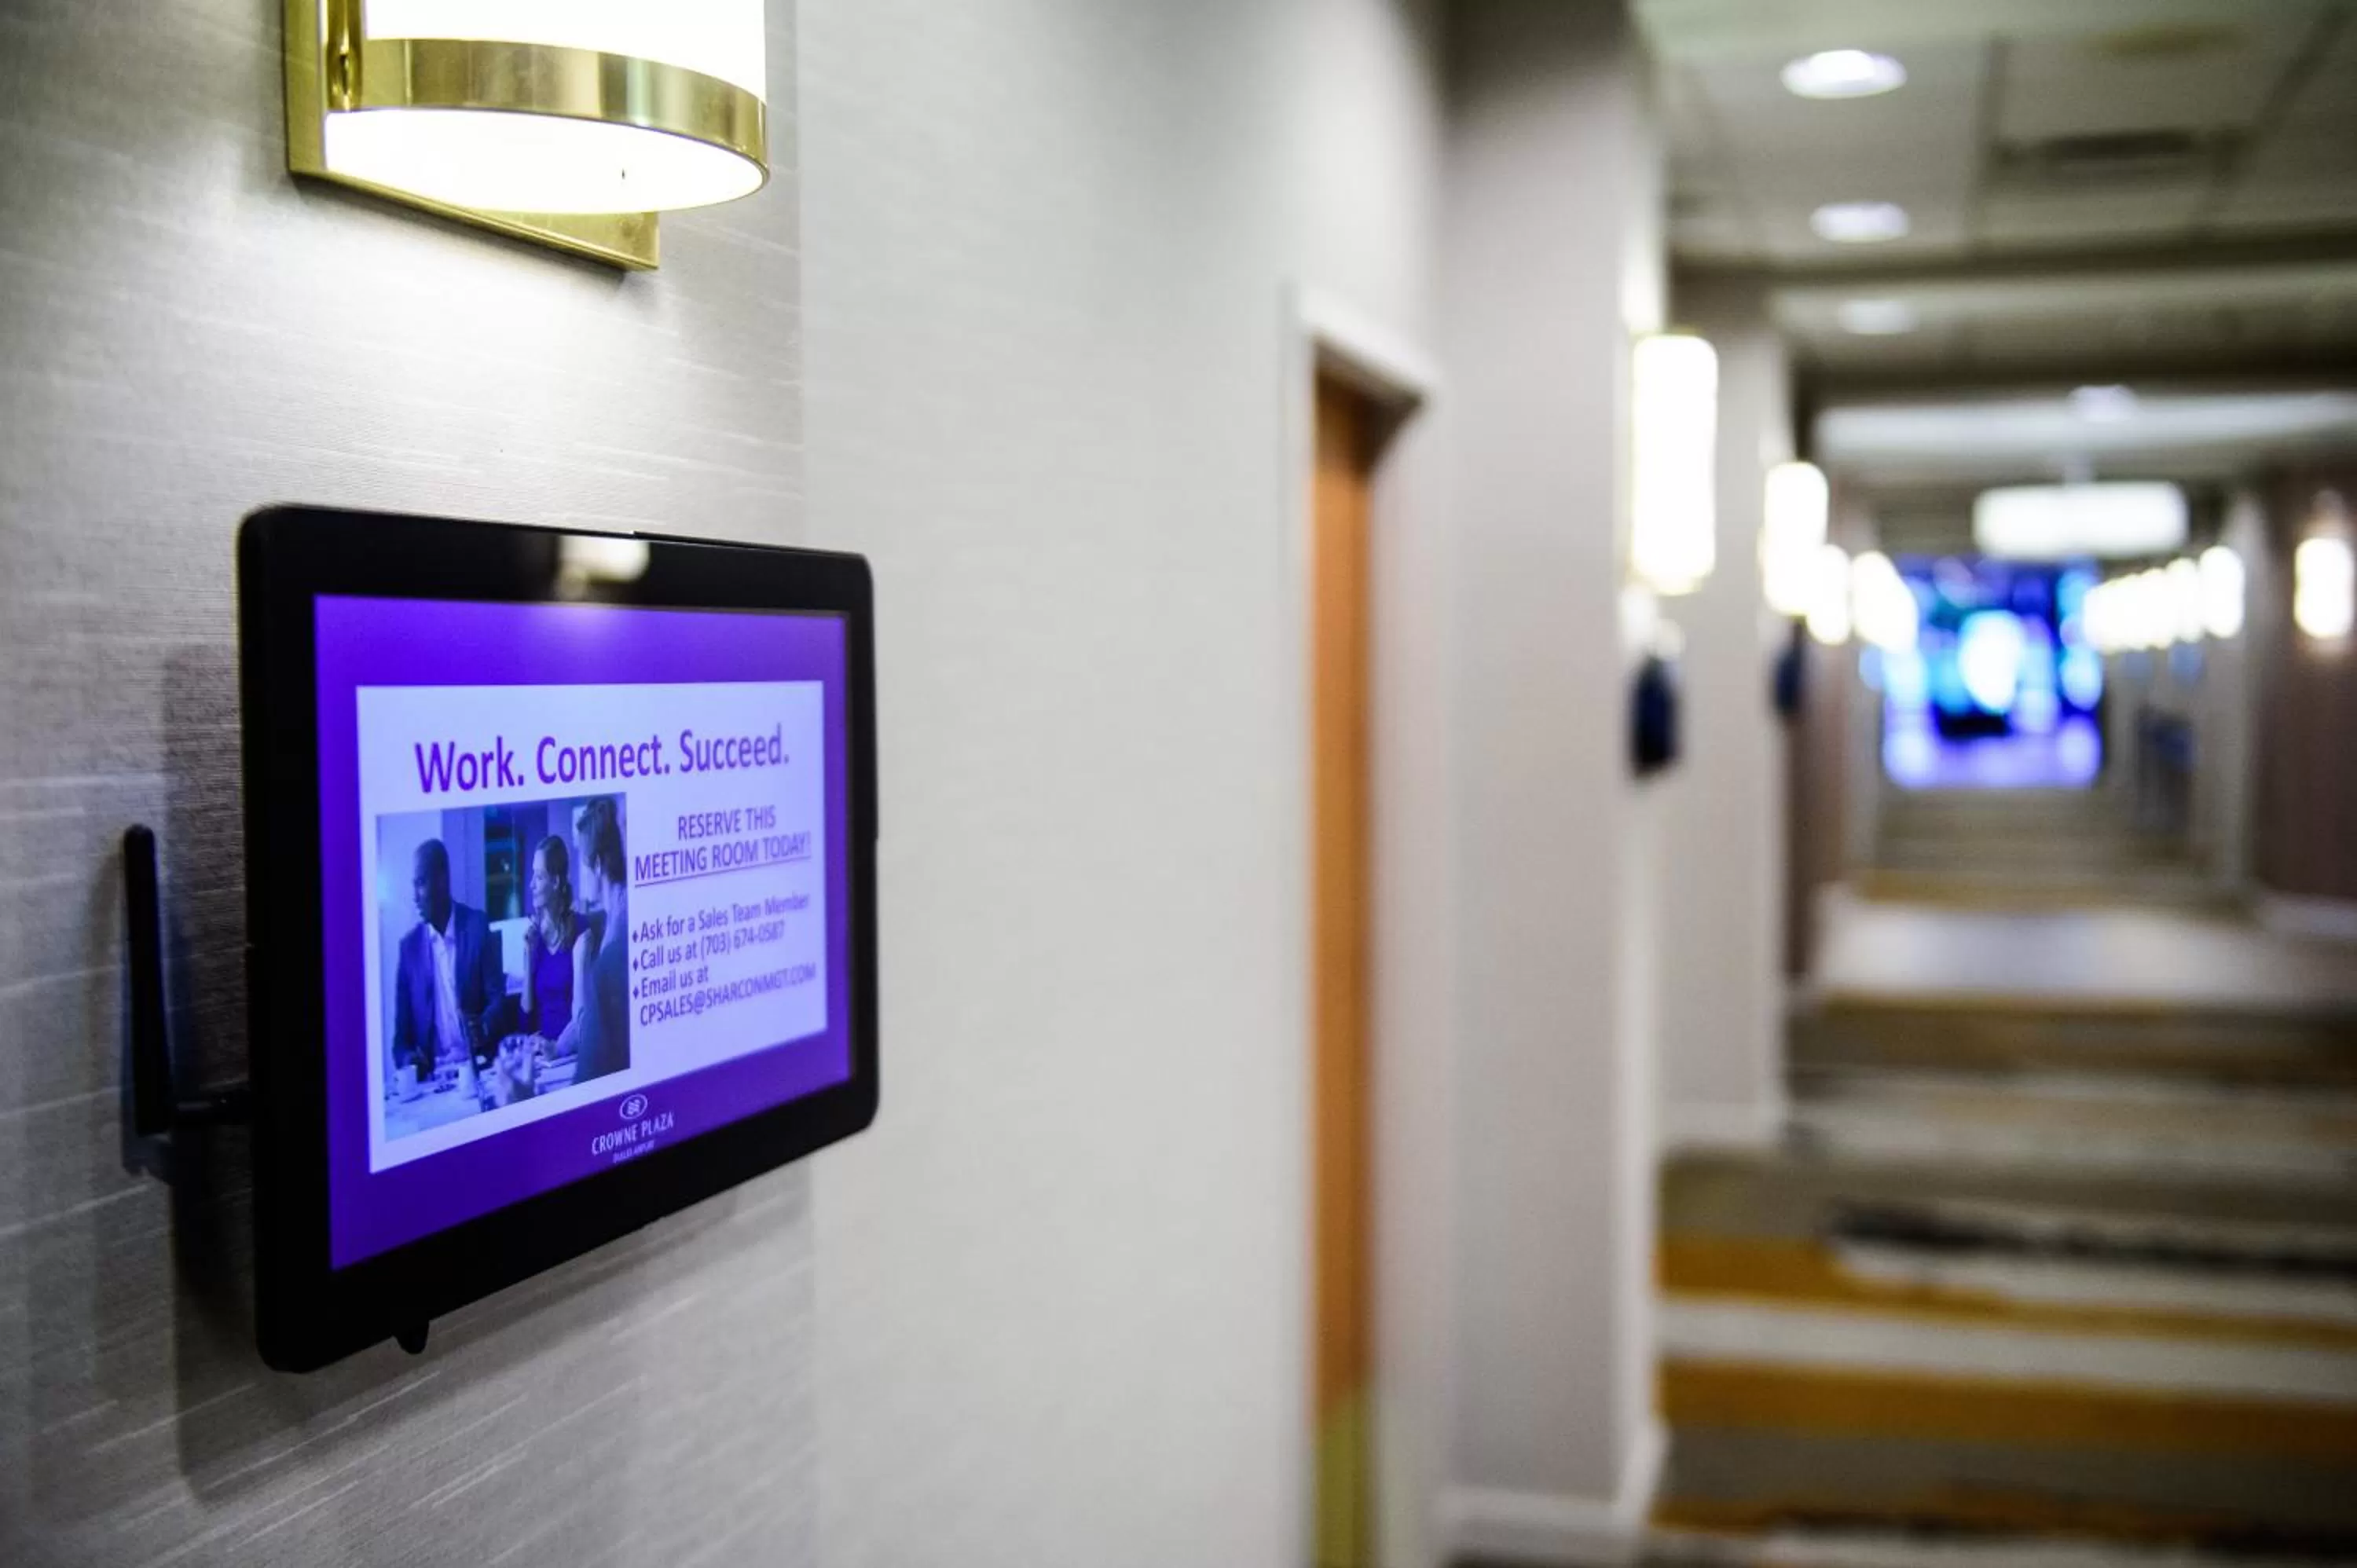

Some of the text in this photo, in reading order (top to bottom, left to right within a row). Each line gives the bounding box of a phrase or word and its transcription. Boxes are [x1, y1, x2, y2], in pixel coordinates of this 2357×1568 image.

[415, 723, 790, 793] Work. Connect. Succeed.
[678, 804, 776, 841] RESERVE THIS
[635, 830, 811, 881] MEETING ROOM TODAY!
[640, 918, 663, 943] Ask
[667, 915, 684, 937] for
[687, 917, 695, 932] a
[699, 906, 728, 930] Sales
[732, 902, 761, 922] Team
[640, 945, 664, 971] Call
[668, 947, 682, 965] us
[685, 941, 697, 960] at
[701, 930, 731, 962] (703)
[642, 965, 709, 998] Email us at
[592, 1123, 638, 1156] CROWNE
[641, 1111, 674, 1138] PLAZA
